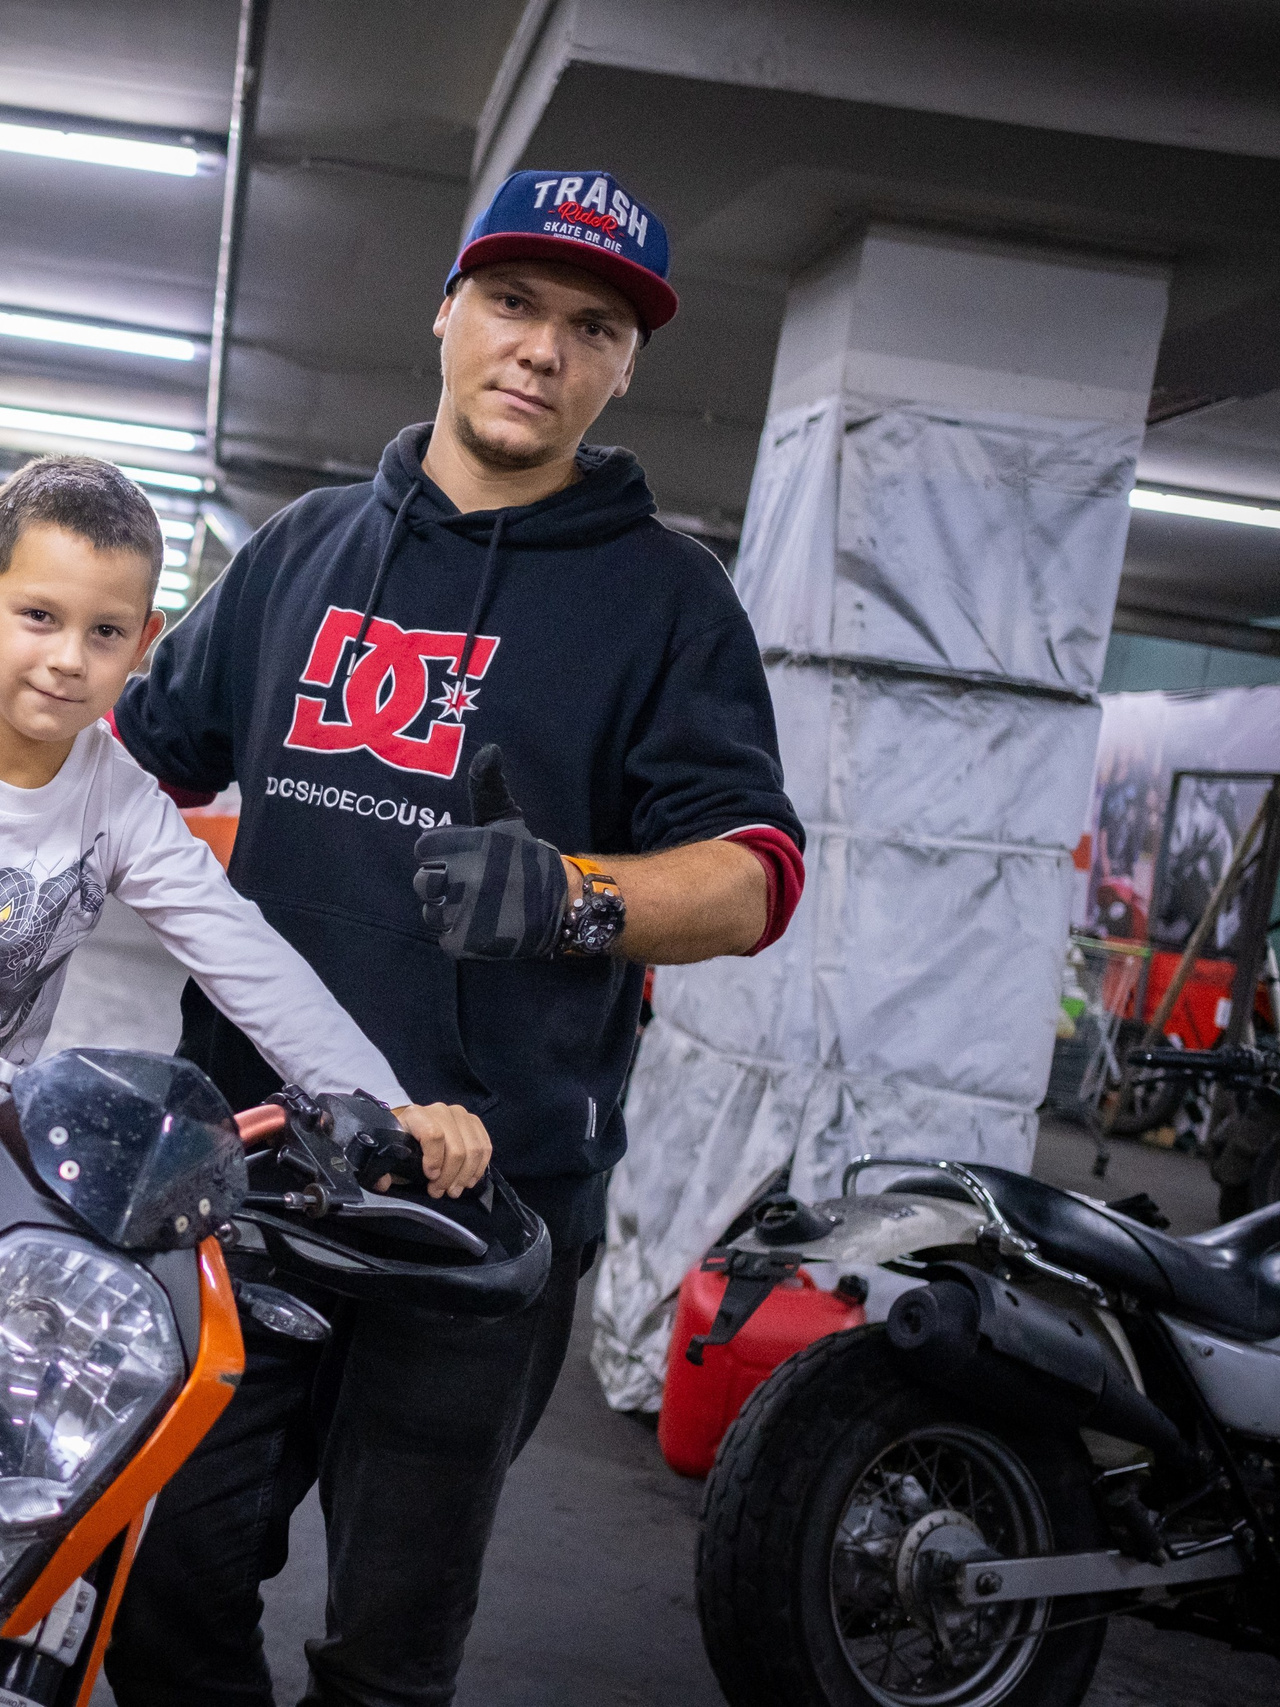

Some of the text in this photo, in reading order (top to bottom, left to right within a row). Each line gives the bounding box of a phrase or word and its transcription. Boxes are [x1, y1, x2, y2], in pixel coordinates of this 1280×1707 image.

[534, 176, 648, 248] TRASH
[543, 221, 582, 237] SKATE
[584, 230, 601, 244] OR
[603, 238, 623, 254] DIE
[266, 776, 453, 827] DCSHOECOUSA
